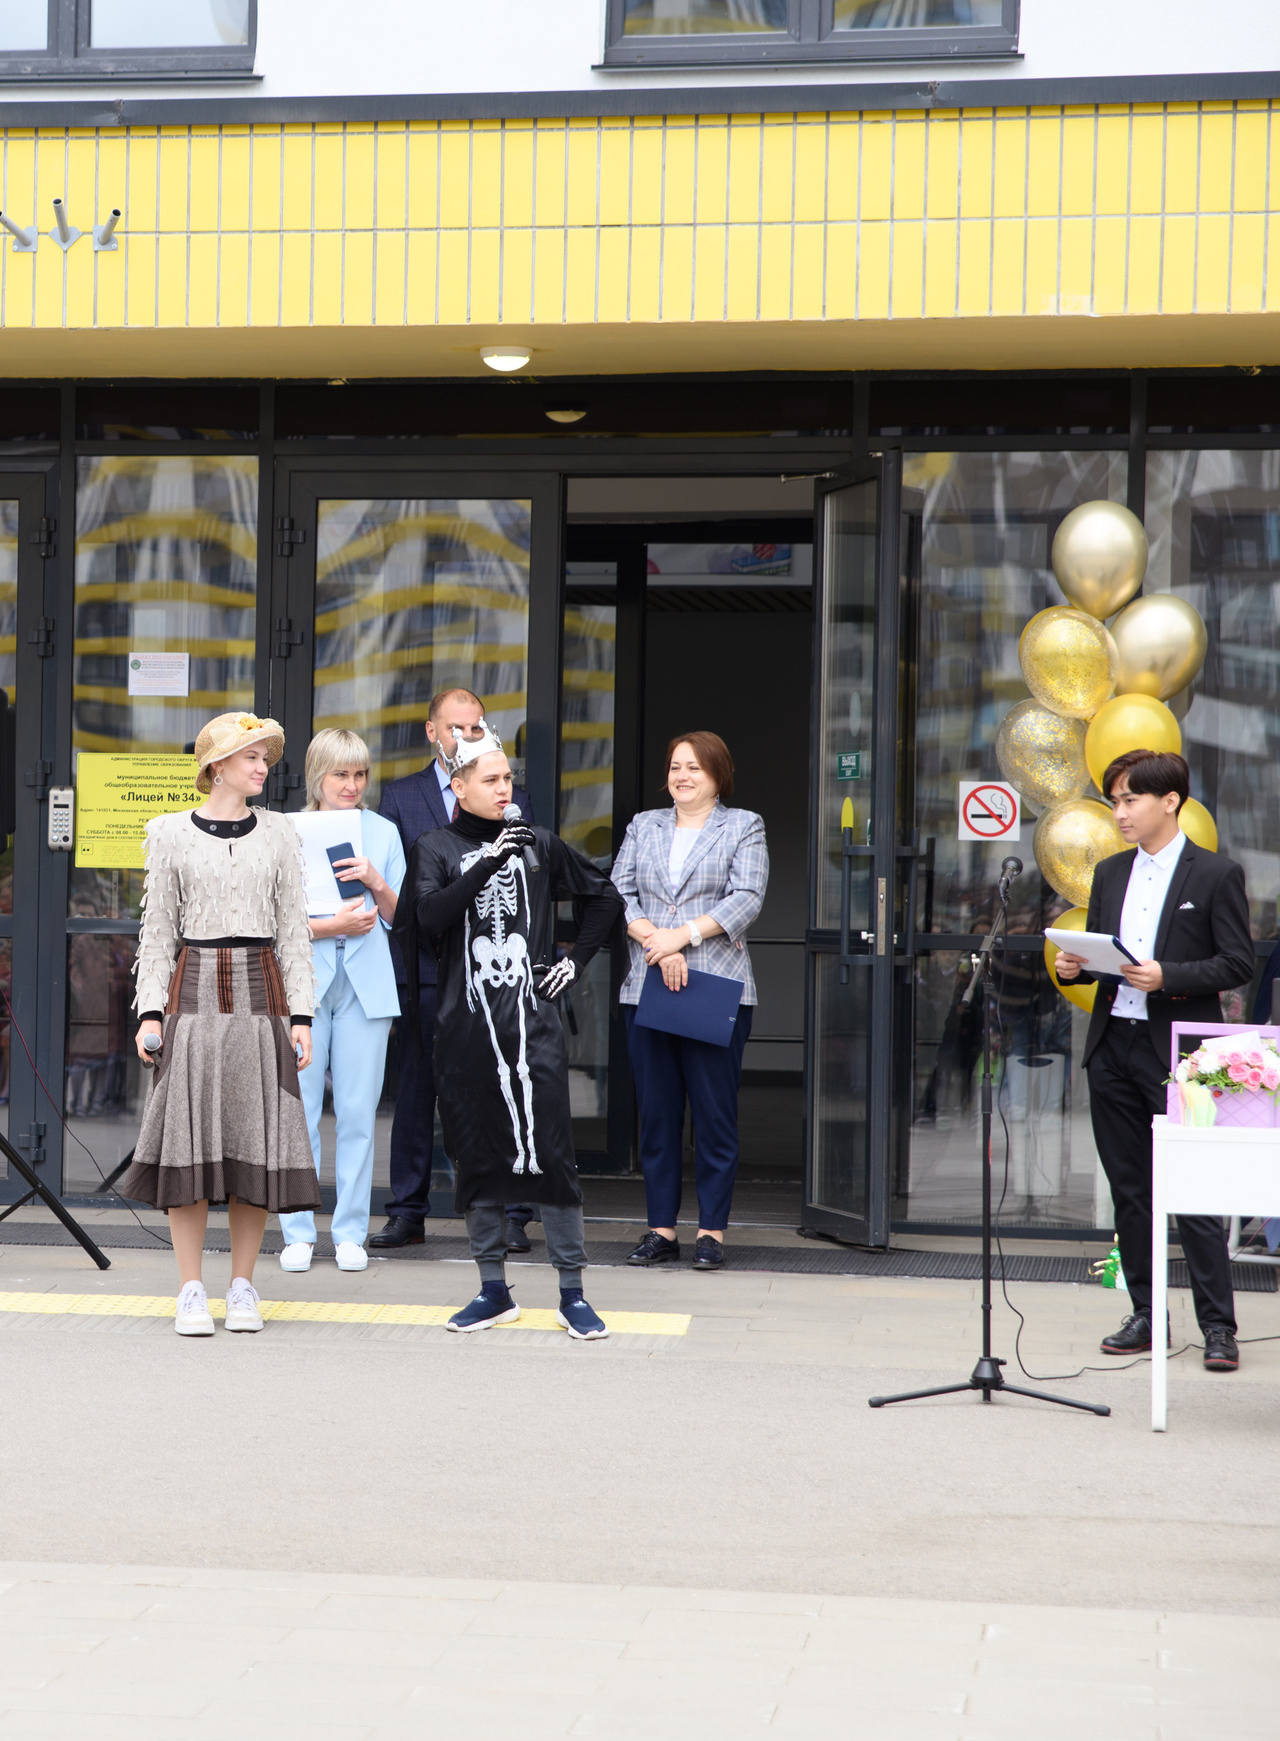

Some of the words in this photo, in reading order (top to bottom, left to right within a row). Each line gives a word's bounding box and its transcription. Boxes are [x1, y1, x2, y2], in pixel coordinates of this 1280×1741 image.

[120, 791, 164, 803] «Лицей
[167, 792, 180, 802] №
[182, 792, 201, 802] 34»
